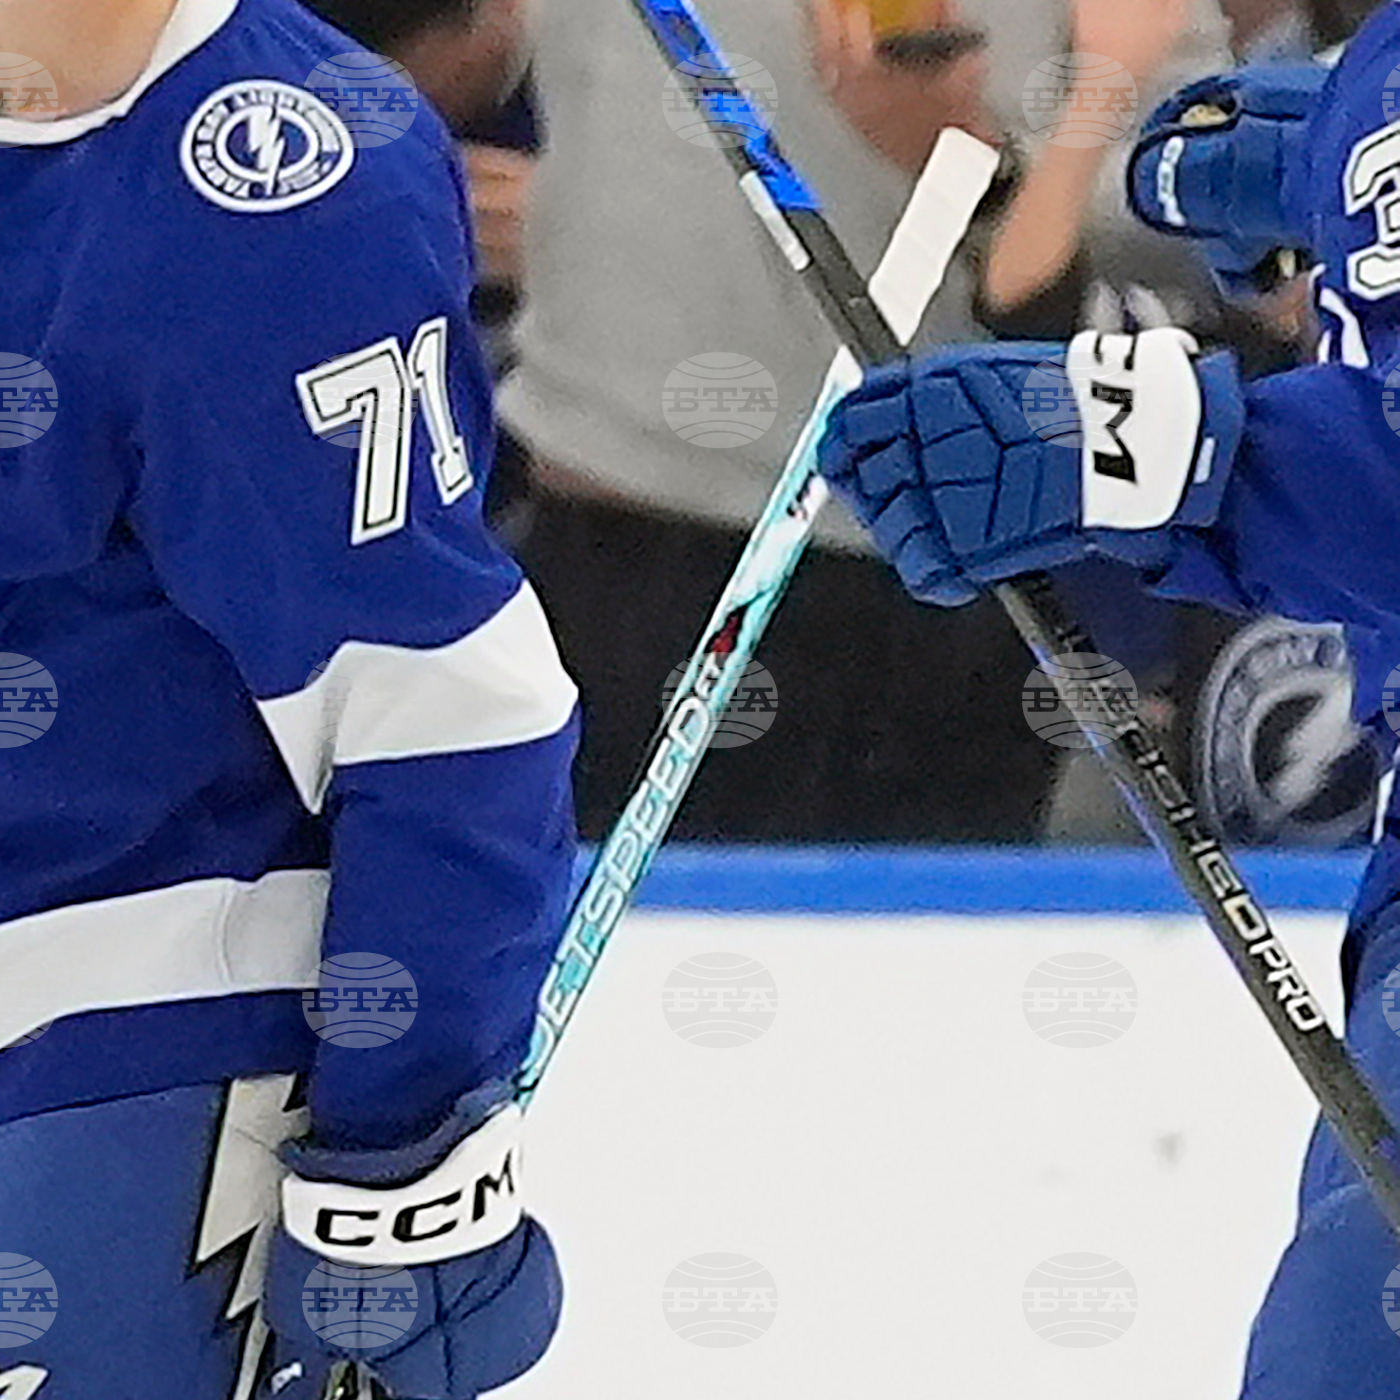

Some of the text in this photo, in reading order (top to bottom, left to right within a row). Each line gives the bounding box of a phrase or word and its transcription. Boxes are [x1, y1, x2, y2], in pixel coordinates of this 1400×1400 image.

[295, 316, 474, 546] 71
[521, 695, 716, 1084] JETSPEED
[314, 1148, 515, 1247] CCM
